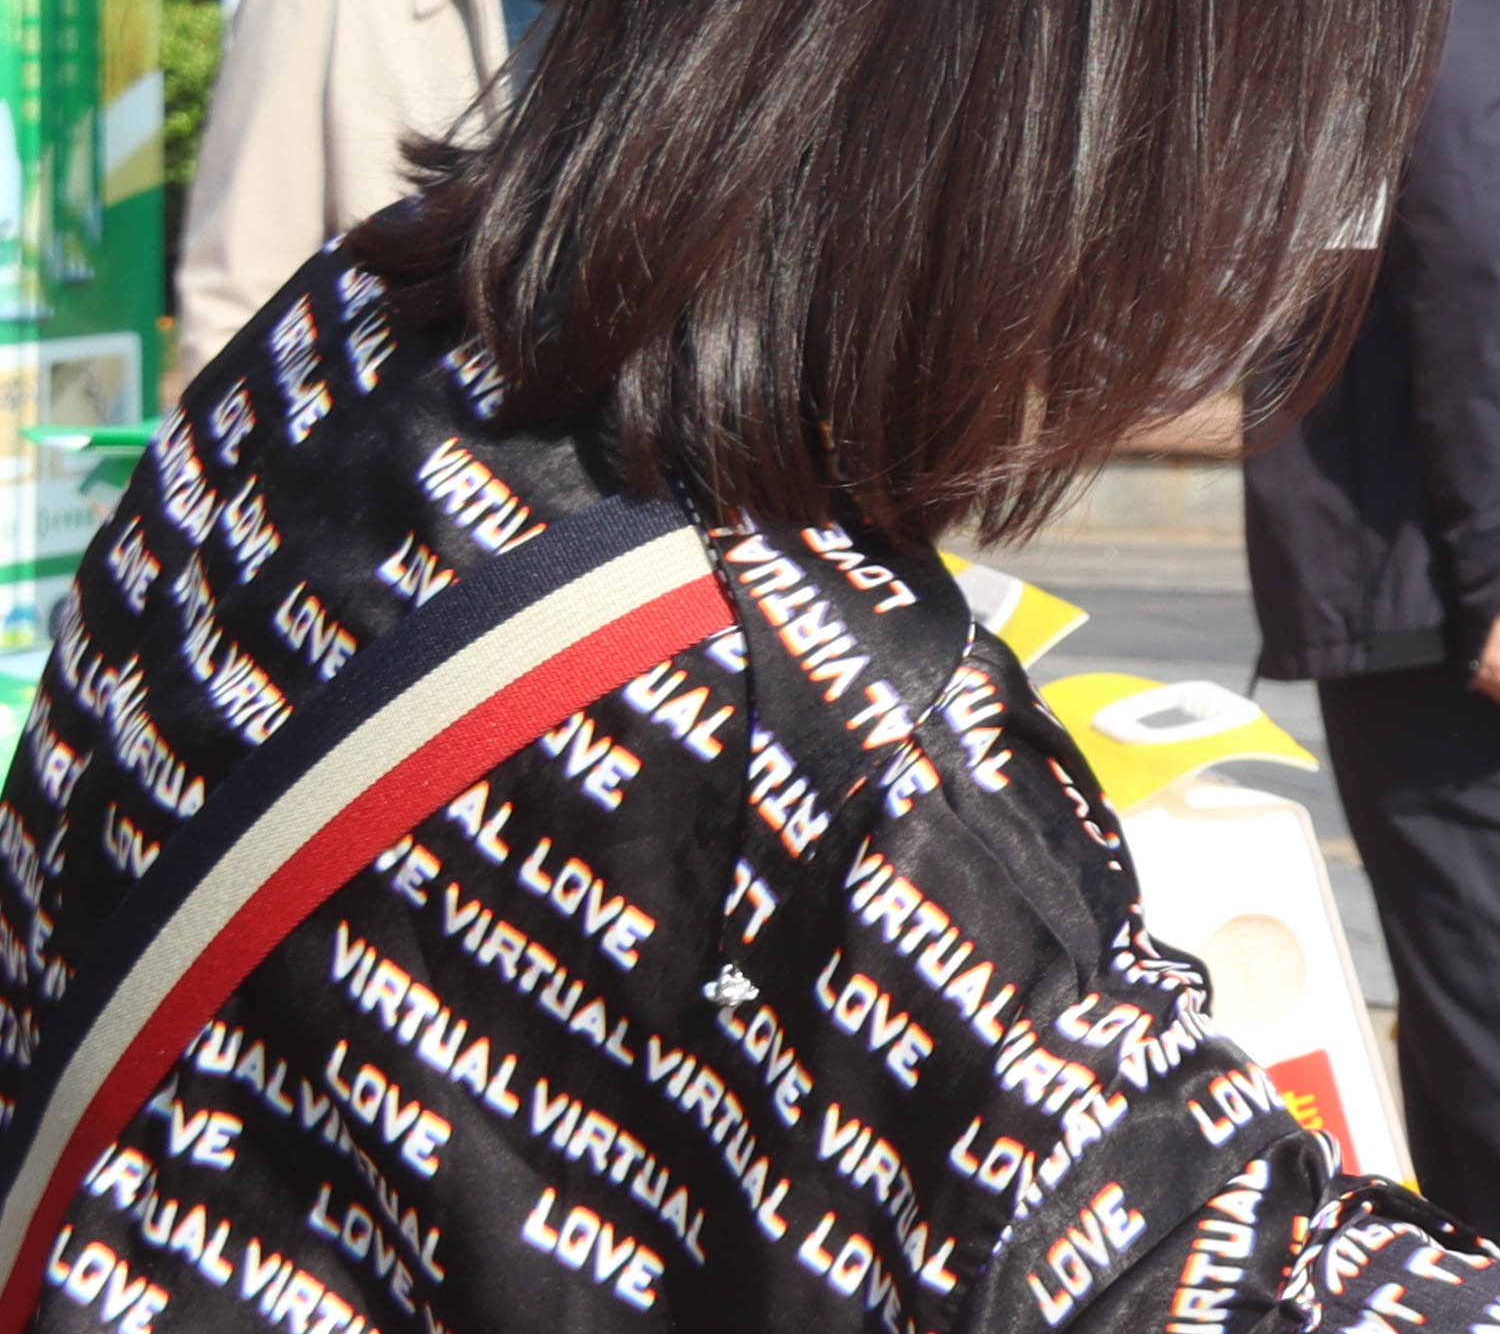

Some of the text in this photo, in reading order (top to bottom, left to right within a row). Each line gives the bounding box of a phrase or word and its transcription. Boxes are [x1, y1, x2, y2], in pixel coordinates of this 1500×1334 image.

[222, 473, 282, 585] LOVE
[416, 436, 547, 555] VIRTU
[272, 579, 358, 681] LOVE
[376, 530, 460, 608] LOV
[209, 641, 294, 745] VIRTU
[104, 800, 160, 879] LOV
[518, 837, 656, 969] LOVE
[443, 882, 636, 1065] VIRTUAL
[844, 835, 1022, 1047] VIRTUAL
[330, 920, 521, 1117] VIRTUAL
[814, 948, 935, 1089] LOVE
[323, 1039, 453, 1177] LOVE
[528, 1076, 706, 1265] VIRTUAL
[647, 1033, 791, 1240] VIRTUAL
[308, 1182, 416, 1315] LOVE
[521, 1185, 666, 1312] LOVE
[1026, 1181, 1148, 1327] LOVE
